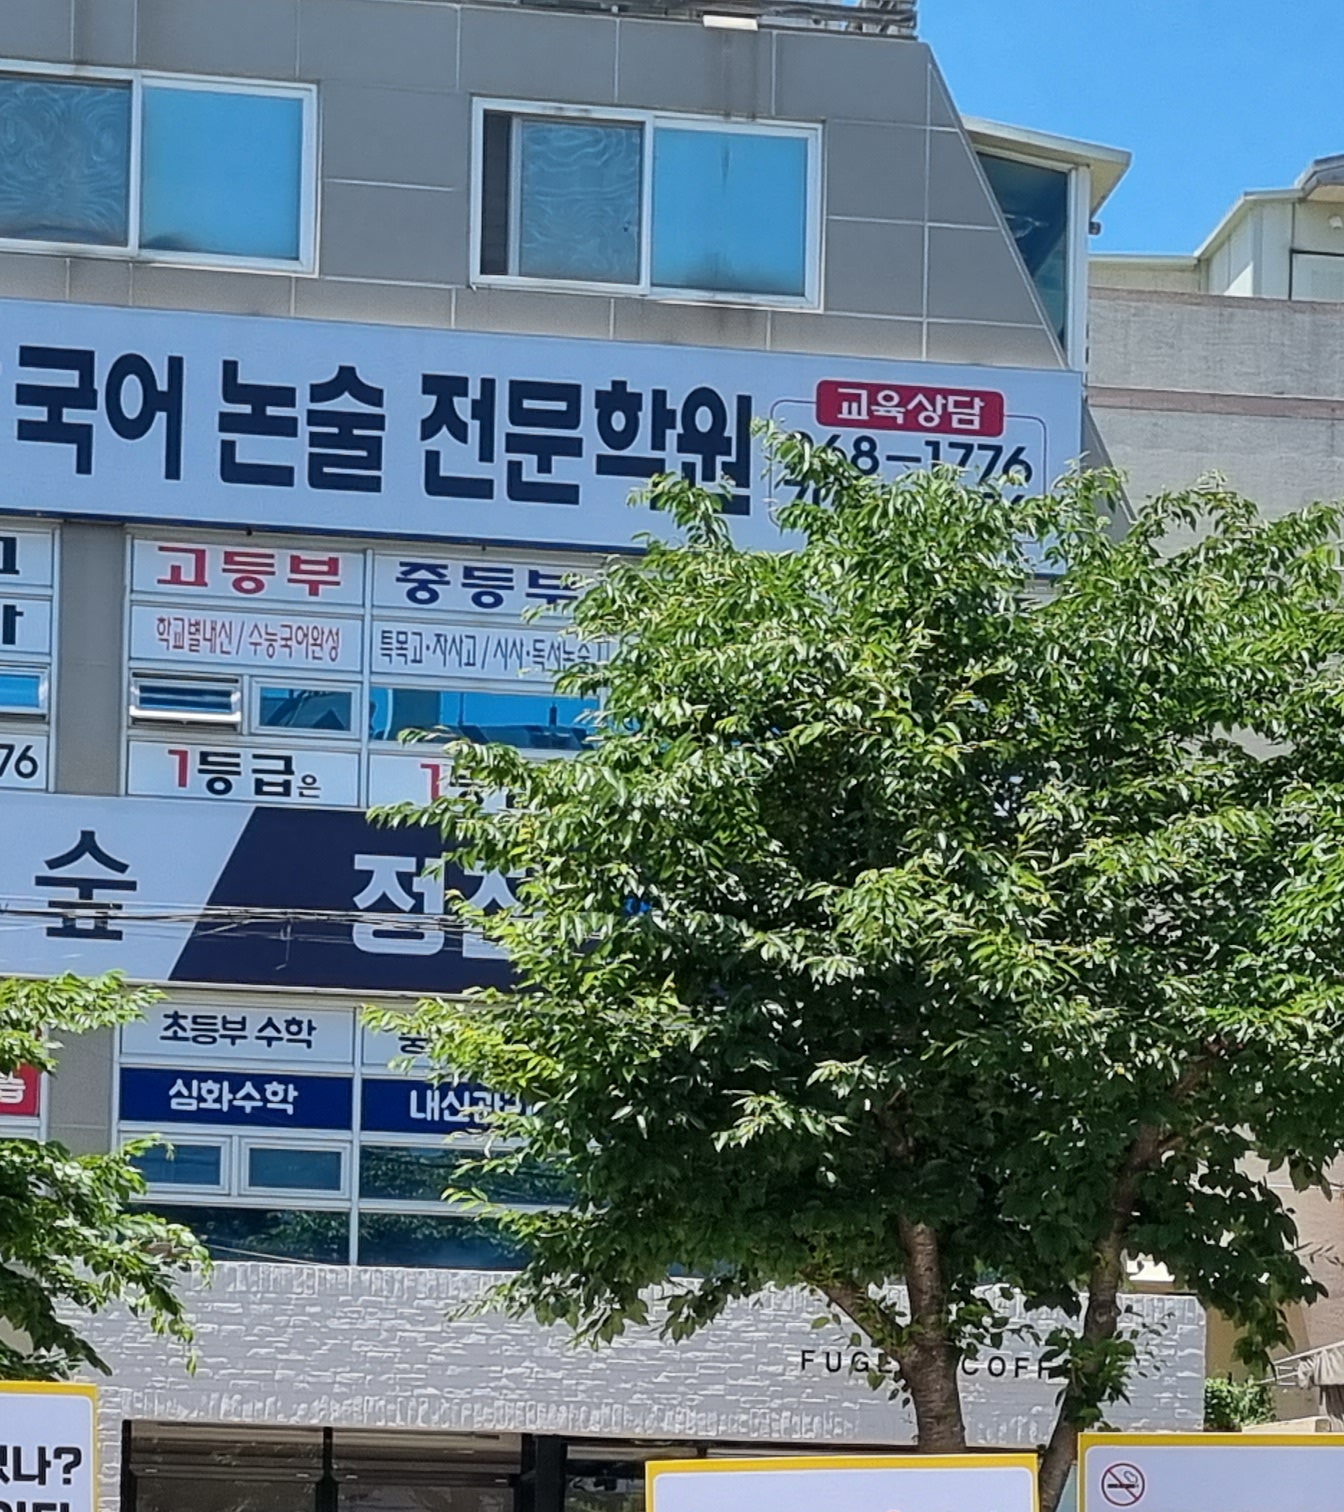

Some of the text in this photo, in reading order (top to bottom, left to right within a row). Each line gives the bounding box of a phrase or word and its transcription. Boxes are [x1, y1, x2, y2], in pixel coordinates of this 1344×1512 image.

[17, 345, 183, 481] 국어
[219, 360, 385, 493] 논술
[420, 373, 752, 515] 전문학원
[837, 387, 984, 430] 교육상담
[157, 546, 340, 596] 고등부
[159, 1010, 318, 1051] 초등부 수학
[168, 1077, 300, 1117] 심화수학
